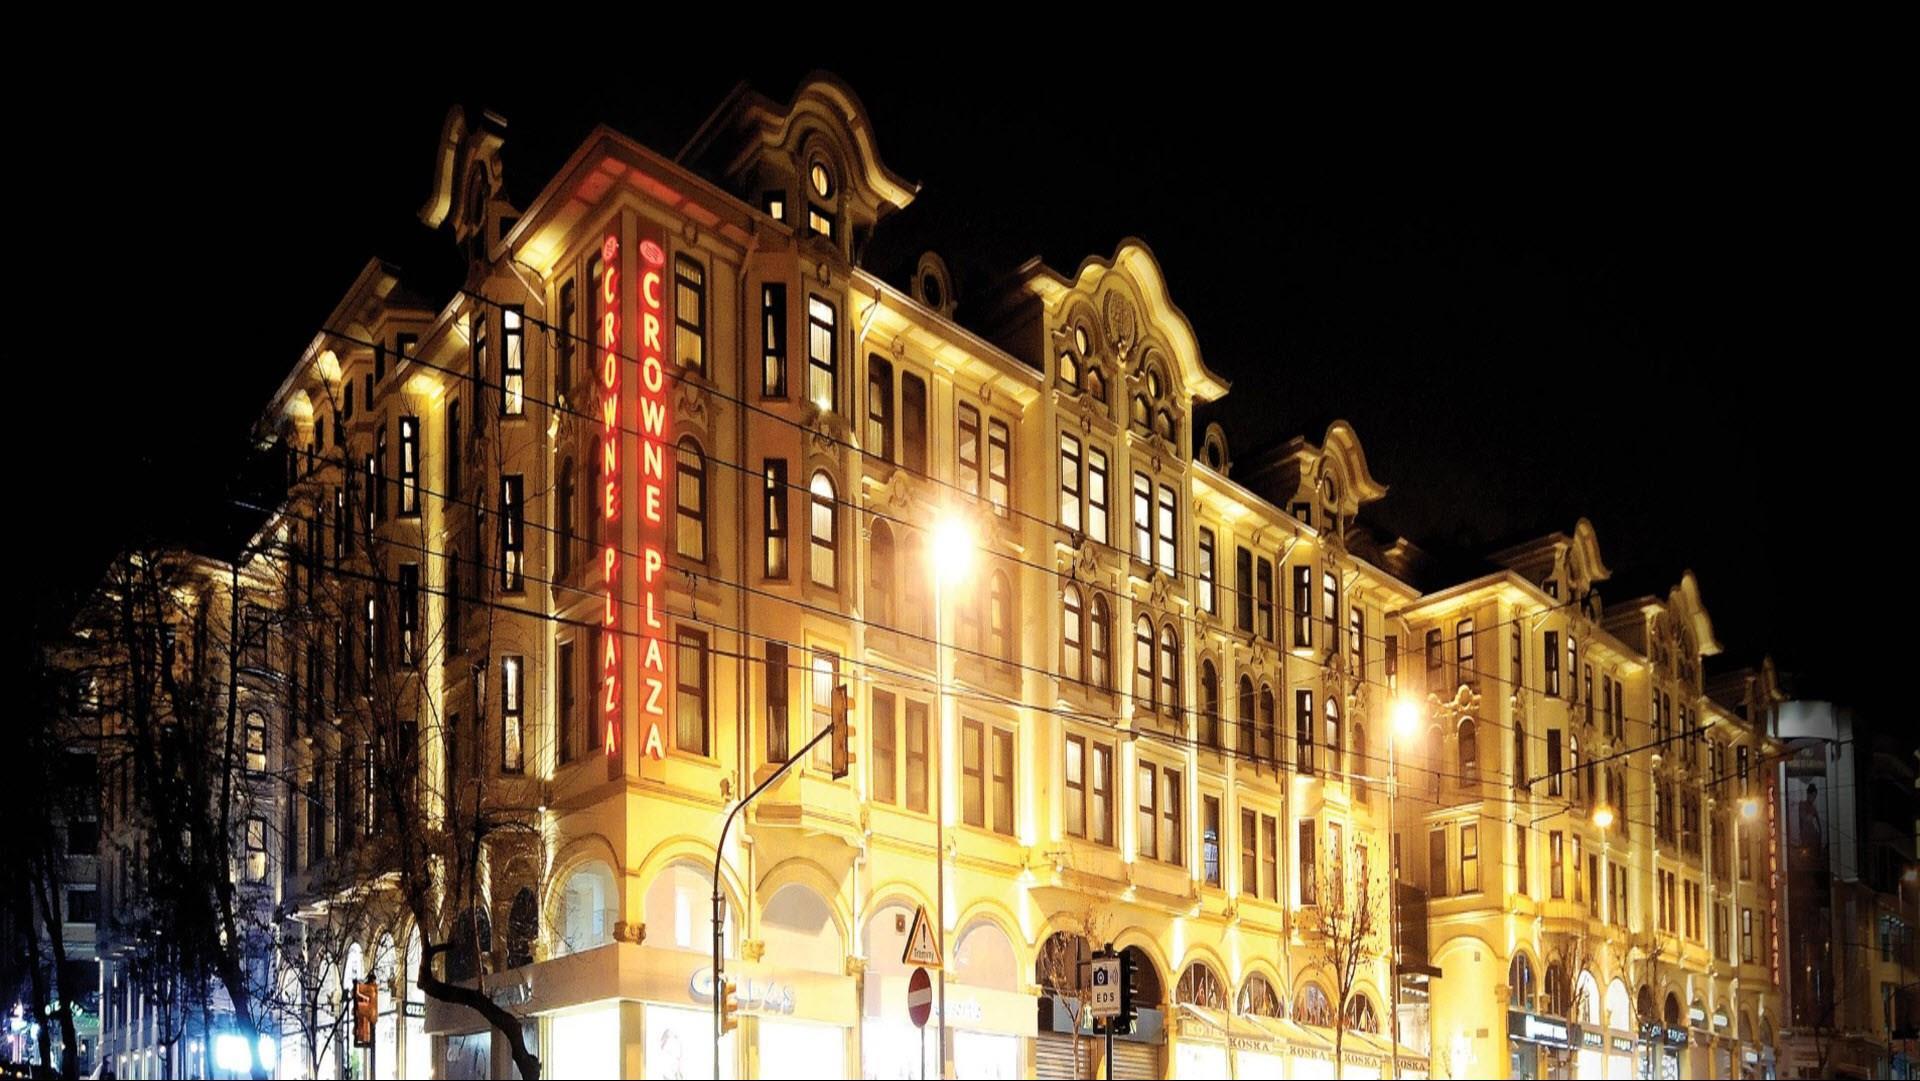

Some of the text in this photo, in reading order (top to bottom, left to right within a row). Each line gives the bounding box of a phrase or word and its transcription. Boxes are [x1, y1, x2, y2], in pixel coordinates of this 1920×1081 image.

[603, 266, 618, 756] CROWNE PLAZA
[641, 271, 665, 759] CROWNE PLAZA
[1096, 992, 1115, 1003] EDS
[1230, 1037, 1270, 1052] KOSKA
[1290, 1045, 1326, 1061] KOSKA
[1344, 1052, 1378, 1067] KOSKA
